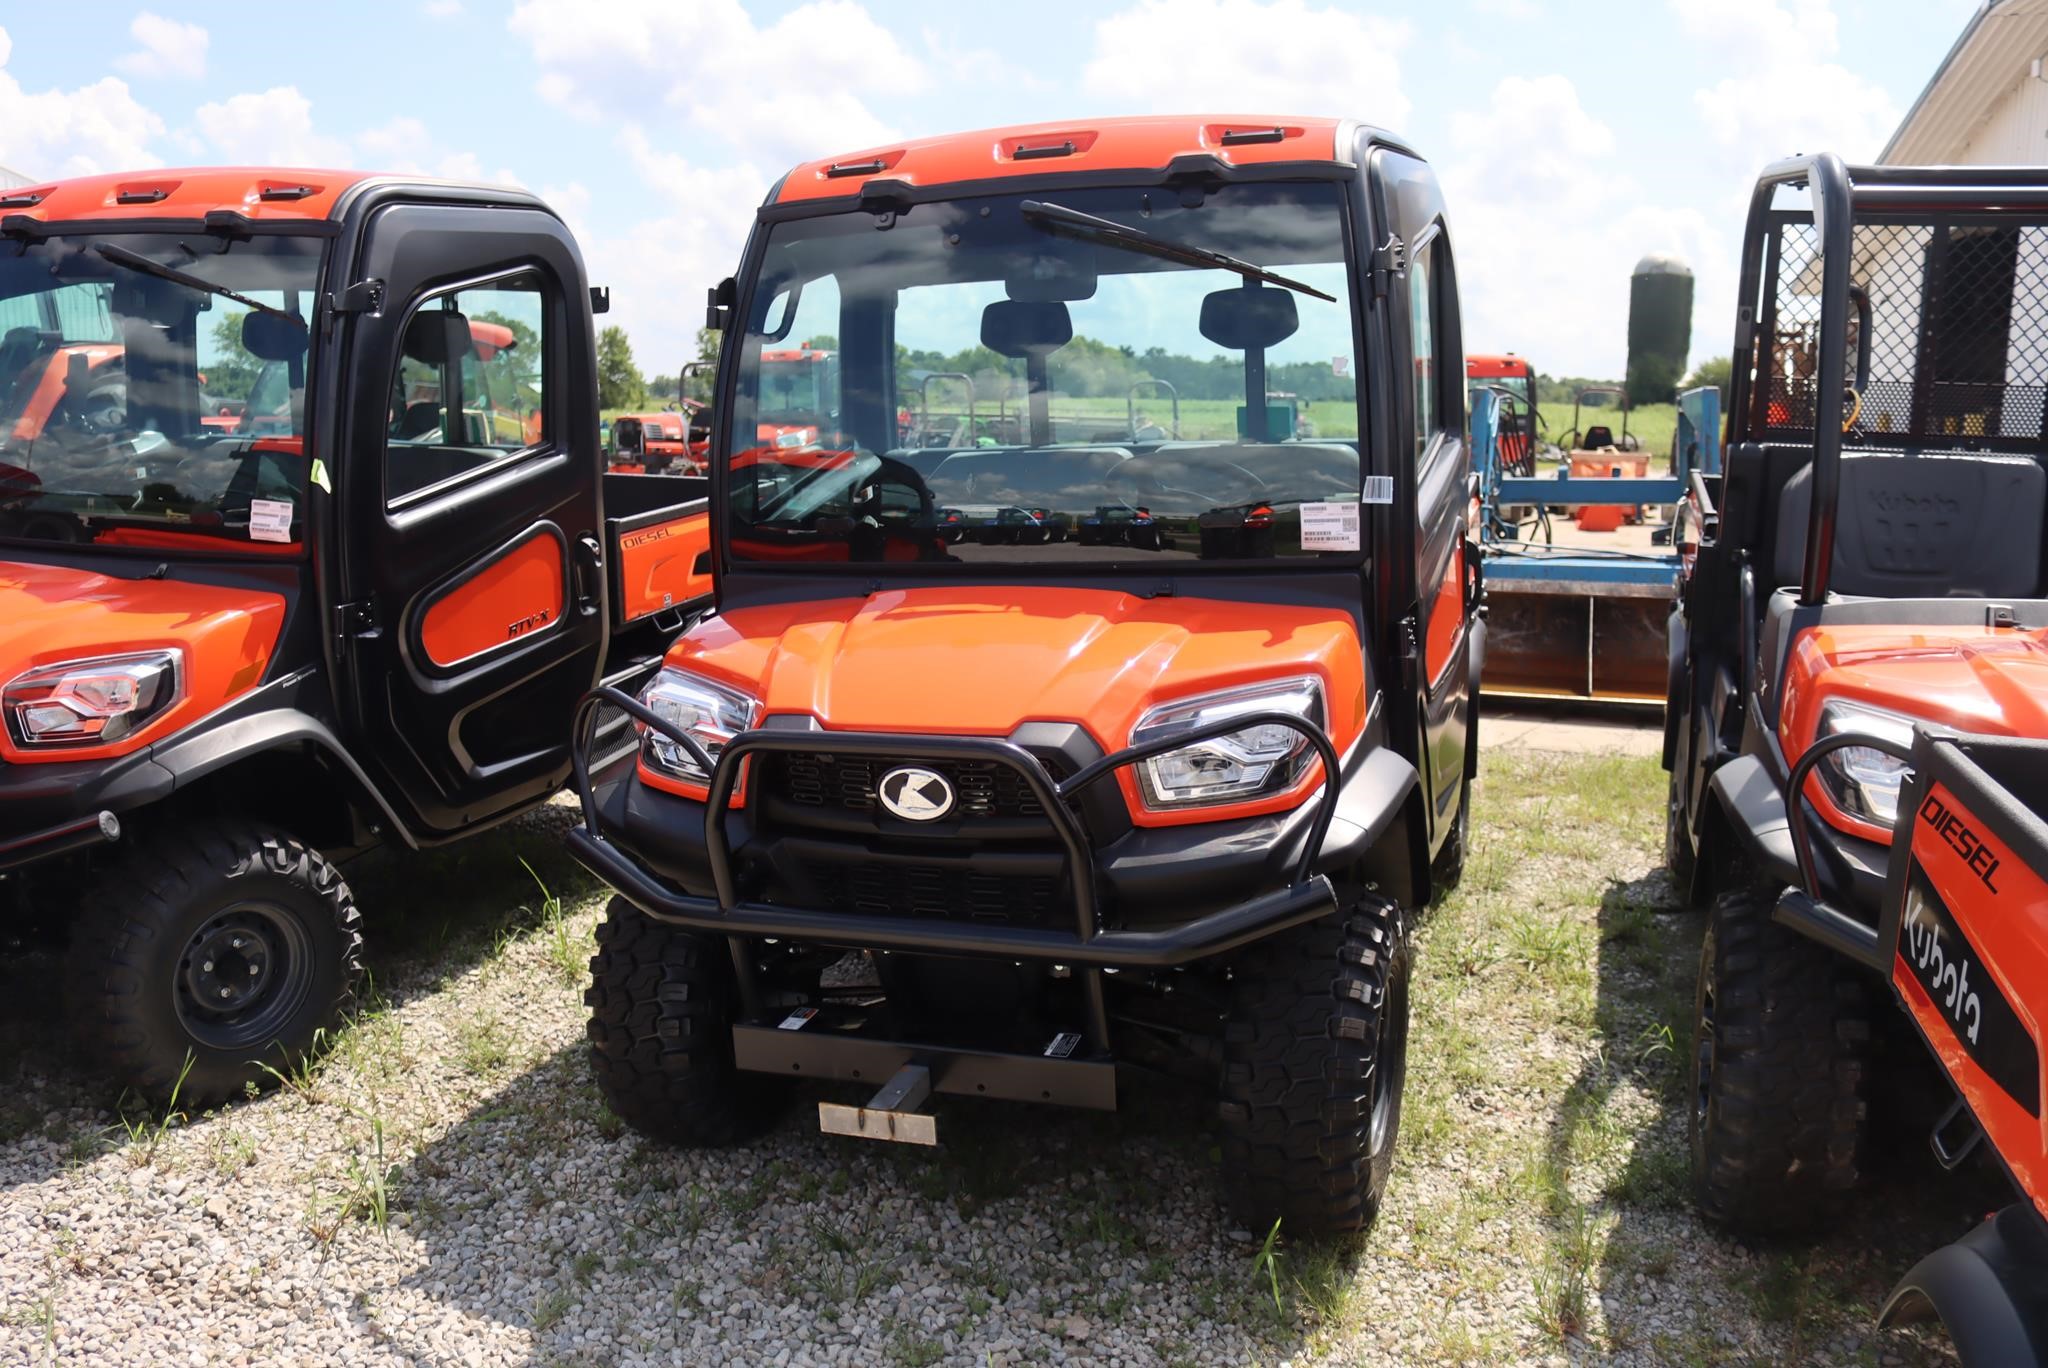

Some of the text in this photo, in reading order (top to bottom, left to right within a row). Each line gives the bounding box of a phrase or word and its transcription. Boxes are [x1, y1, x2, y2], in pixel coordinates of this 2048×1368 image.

[623, 528, 672, 549] DIESEL
[508, 608, 549, 637] RTV-X
[1919, 795, 2000, 895] DIESEL
[1903, 890, 1981, 1046] Kubota
